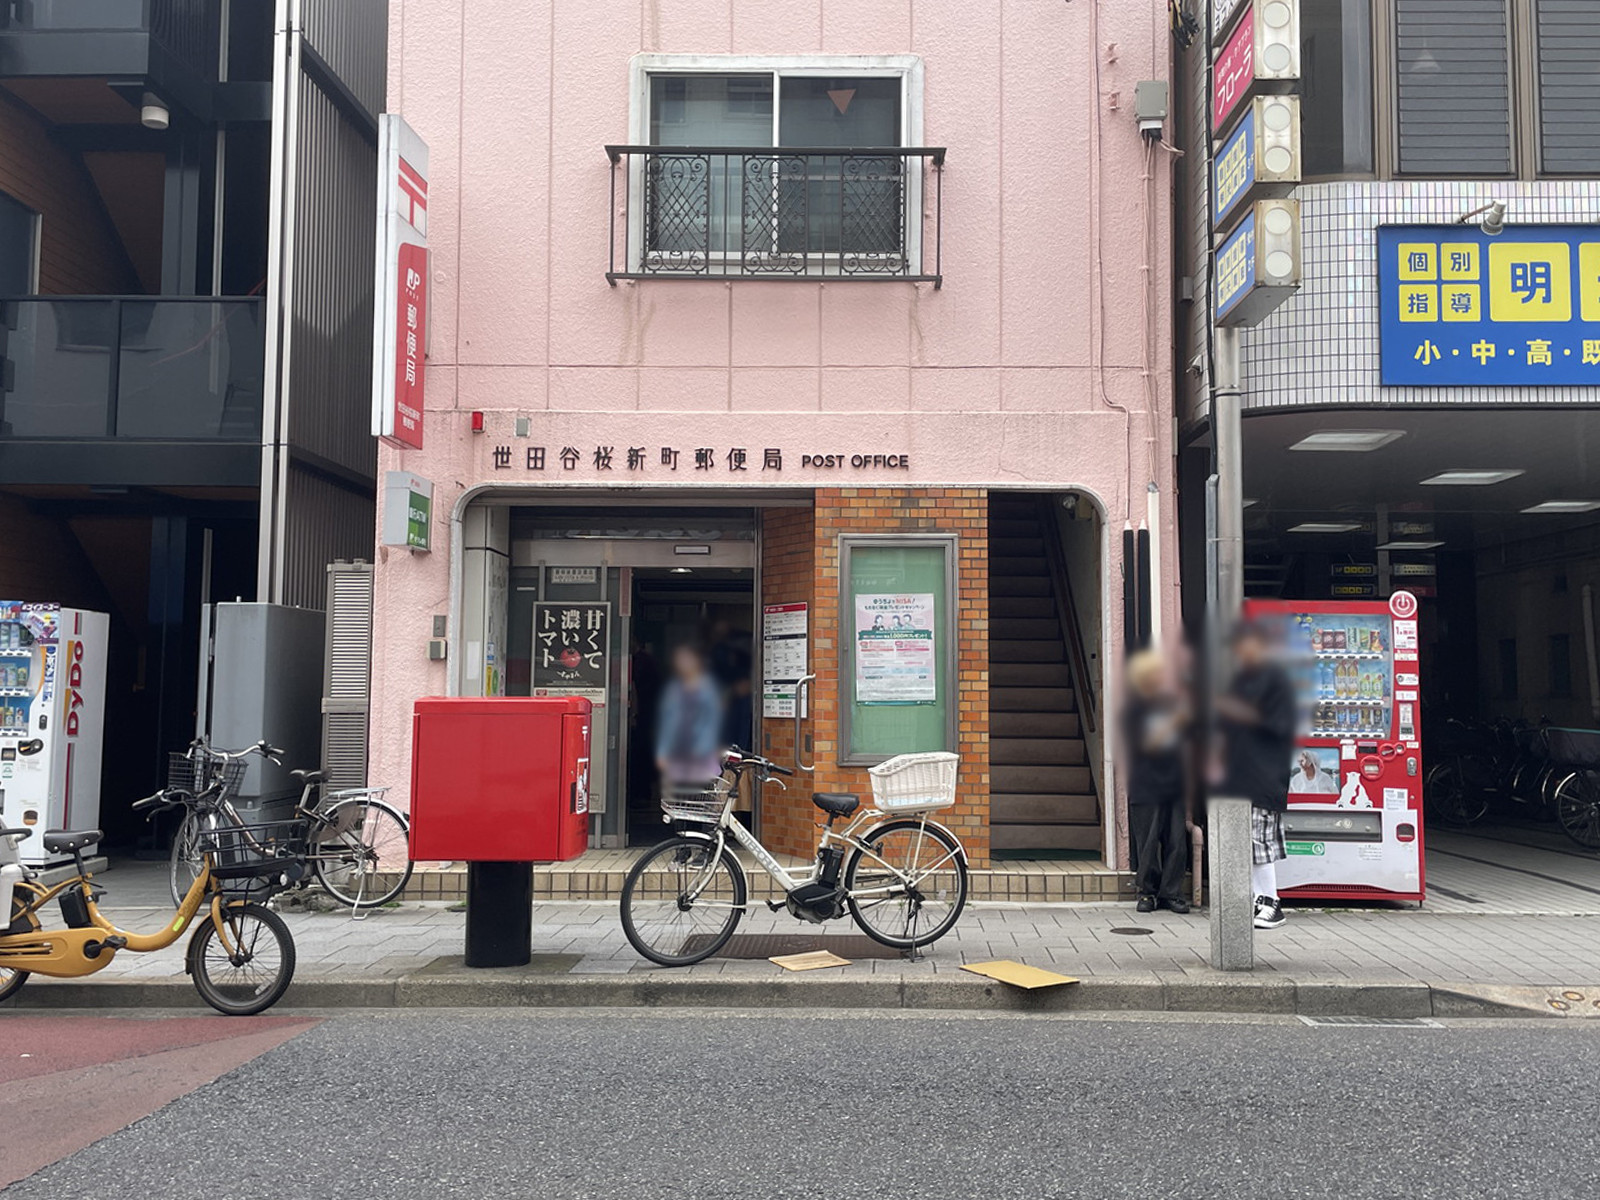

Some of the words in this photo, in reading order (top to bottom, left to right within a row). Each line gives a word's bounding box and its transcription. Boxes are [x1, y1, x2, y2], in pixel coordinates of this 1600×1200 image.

[1217, 43, 1252, 116] フローラ
[1407, 251, 1471, 272] 個別
[1407, 292, 1472, 314] 指導
[405, 303, 418, 387] 郵便局
[493, 445, 783, 472] 世田谷桜新町郵便局
[802, 454, 845, 468] POST
[851, 454, 909, 471] OFFICE
[537, 609, 558, 669] トマト
[561, 609, 581, 646] 濃い
[584, 609, 604, 669] 甘くて
